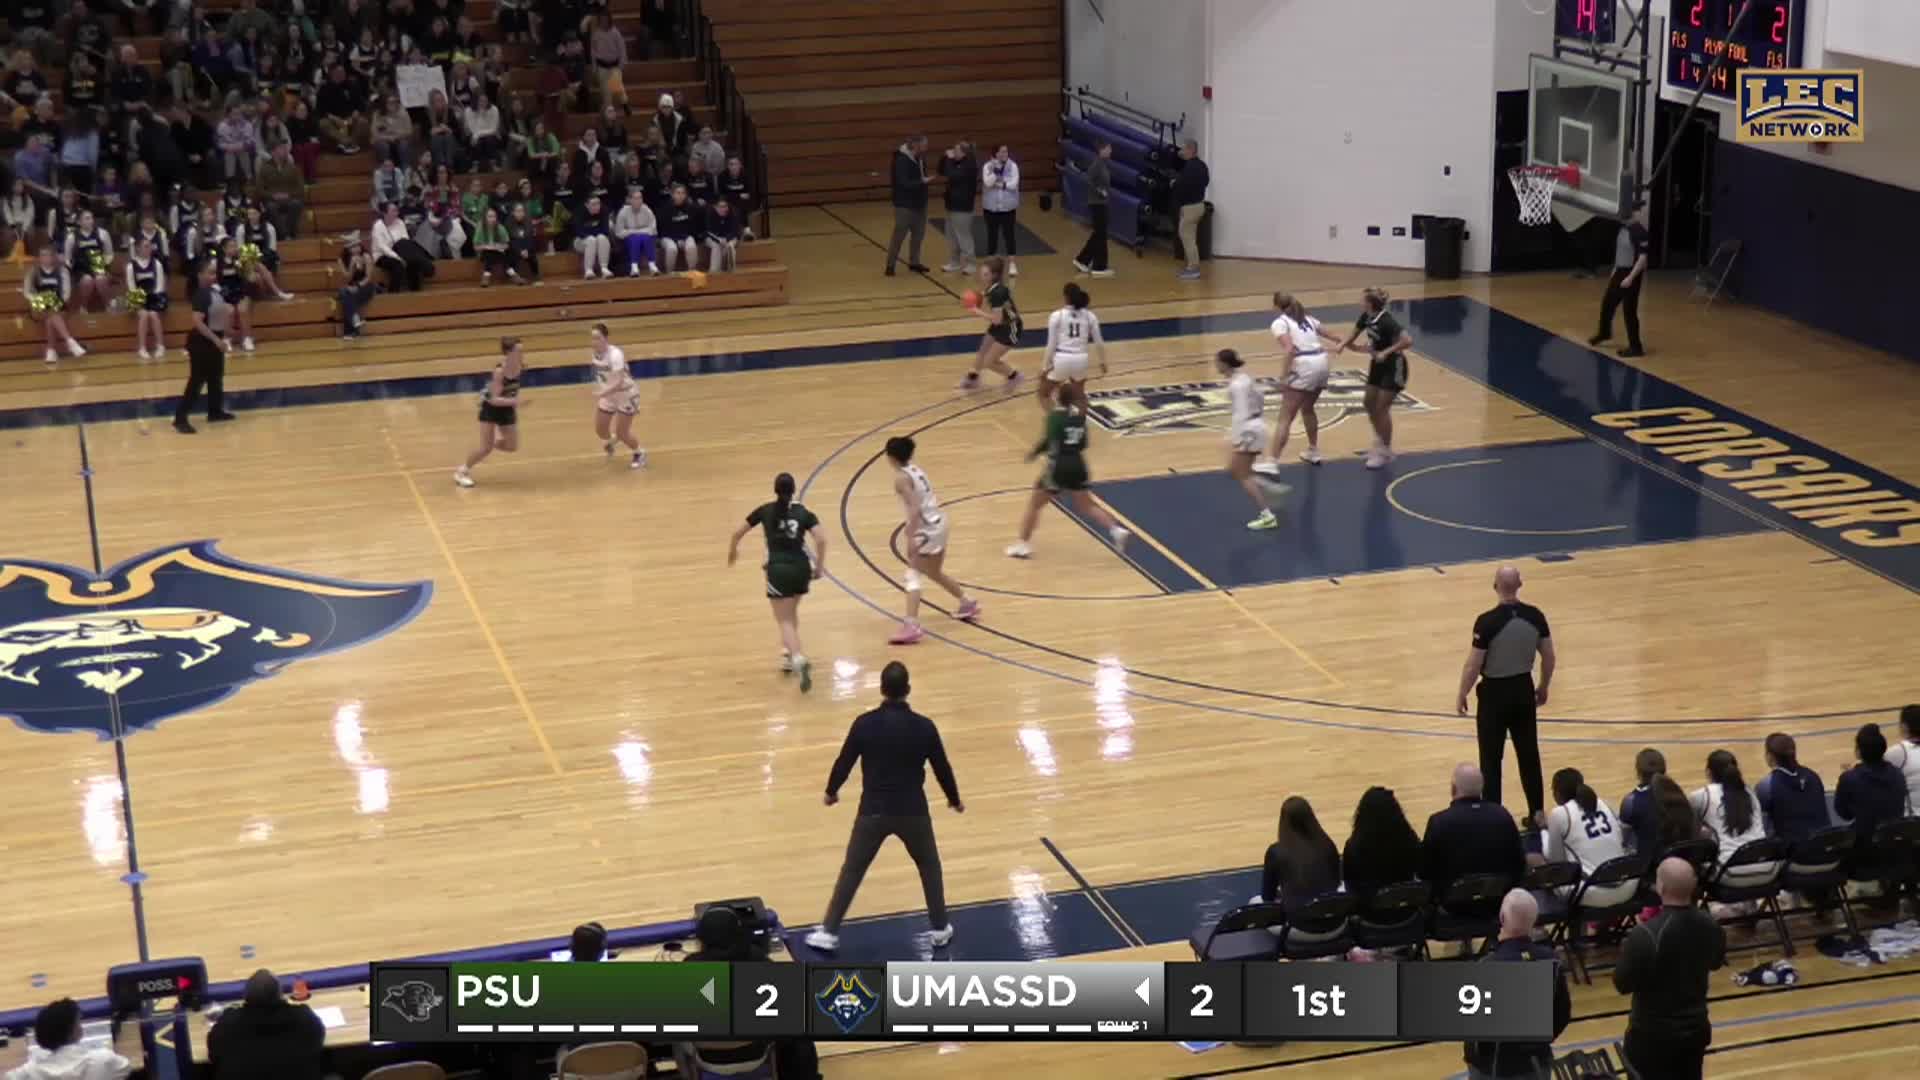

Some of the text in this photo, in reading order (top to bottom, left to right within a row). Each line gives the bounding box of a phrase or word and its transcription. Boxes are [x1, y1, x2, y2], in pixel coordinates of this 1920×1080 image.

[1771, 6, 1785, 43] 2
[1672, 30, 1688, 49] FLS
[1766, 50, 1784, 69] FLS
[1069, 322, 1081, 338] 11
[1591, 406, 1920, 548] CORSAIRS
[1581, 810, 1612, 839] 23
